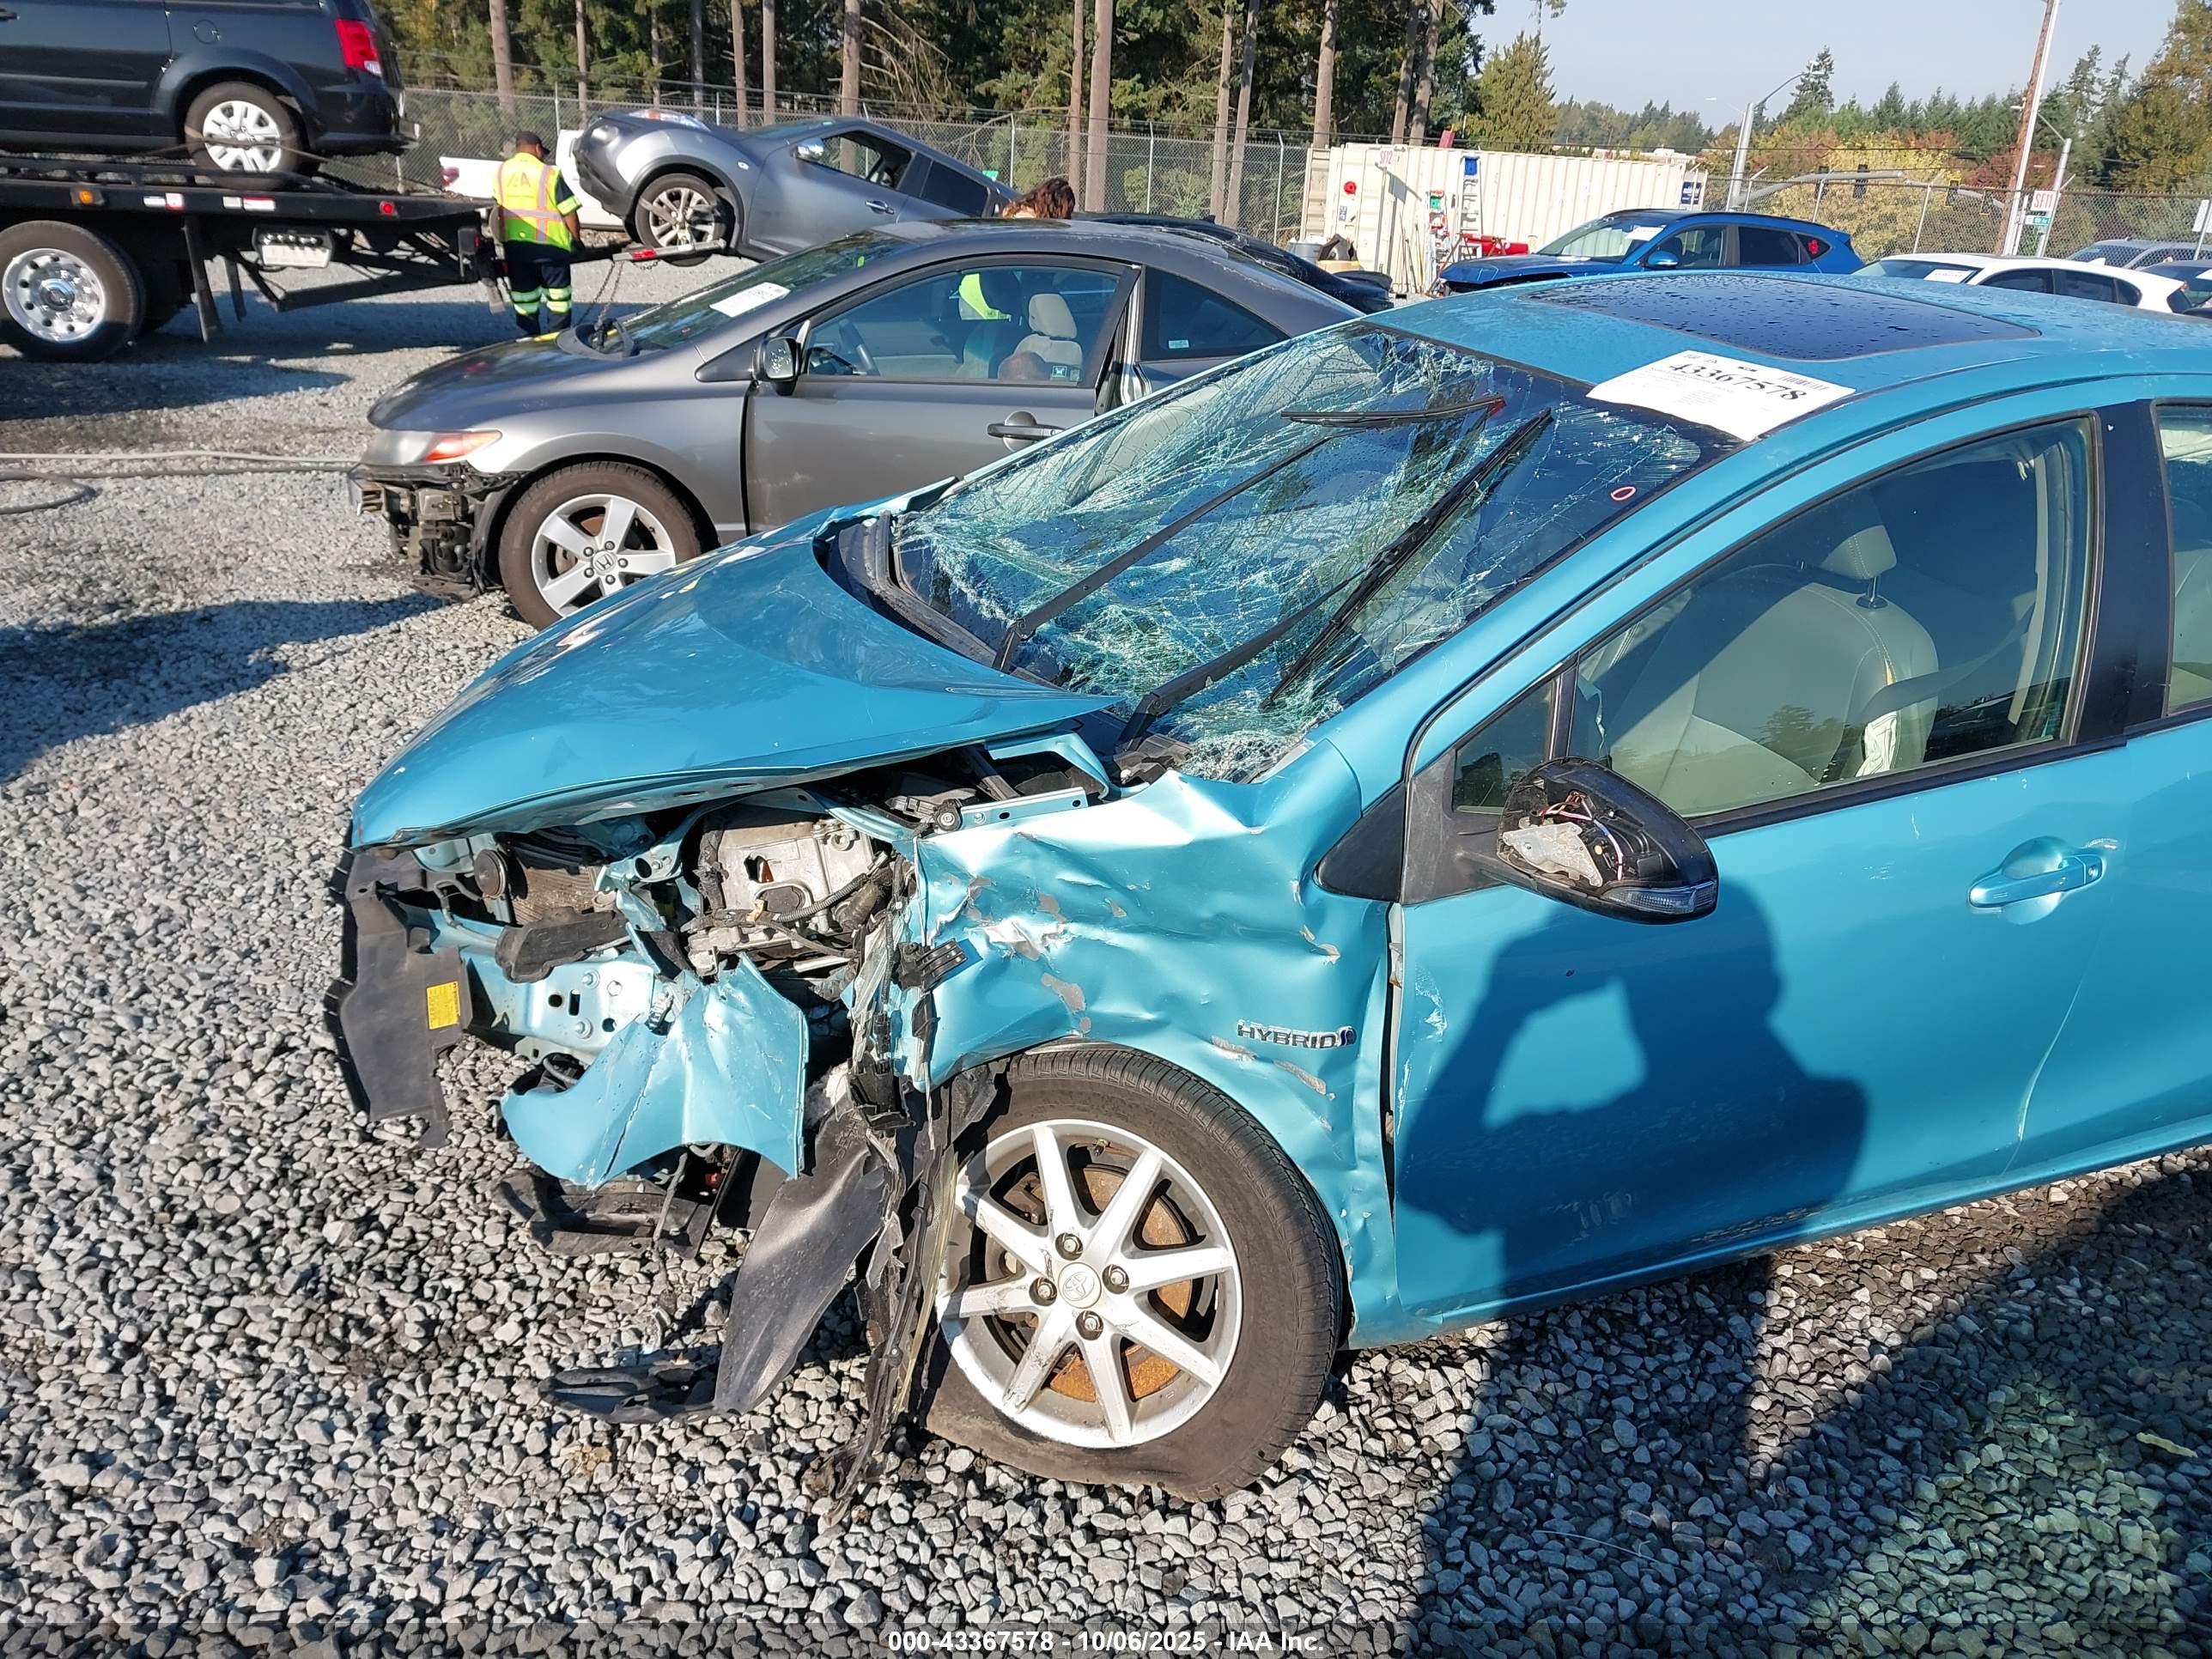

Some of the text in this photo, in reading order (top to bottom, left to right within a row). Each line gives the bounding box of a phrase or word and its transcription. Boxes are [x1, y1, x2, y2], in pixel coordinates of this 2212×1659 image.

[2034, 193, 2053, 208] SF11
[1669, 363, 1807, 400] 43367578
[1237, 1019, 1338, 1049] HYBRID
